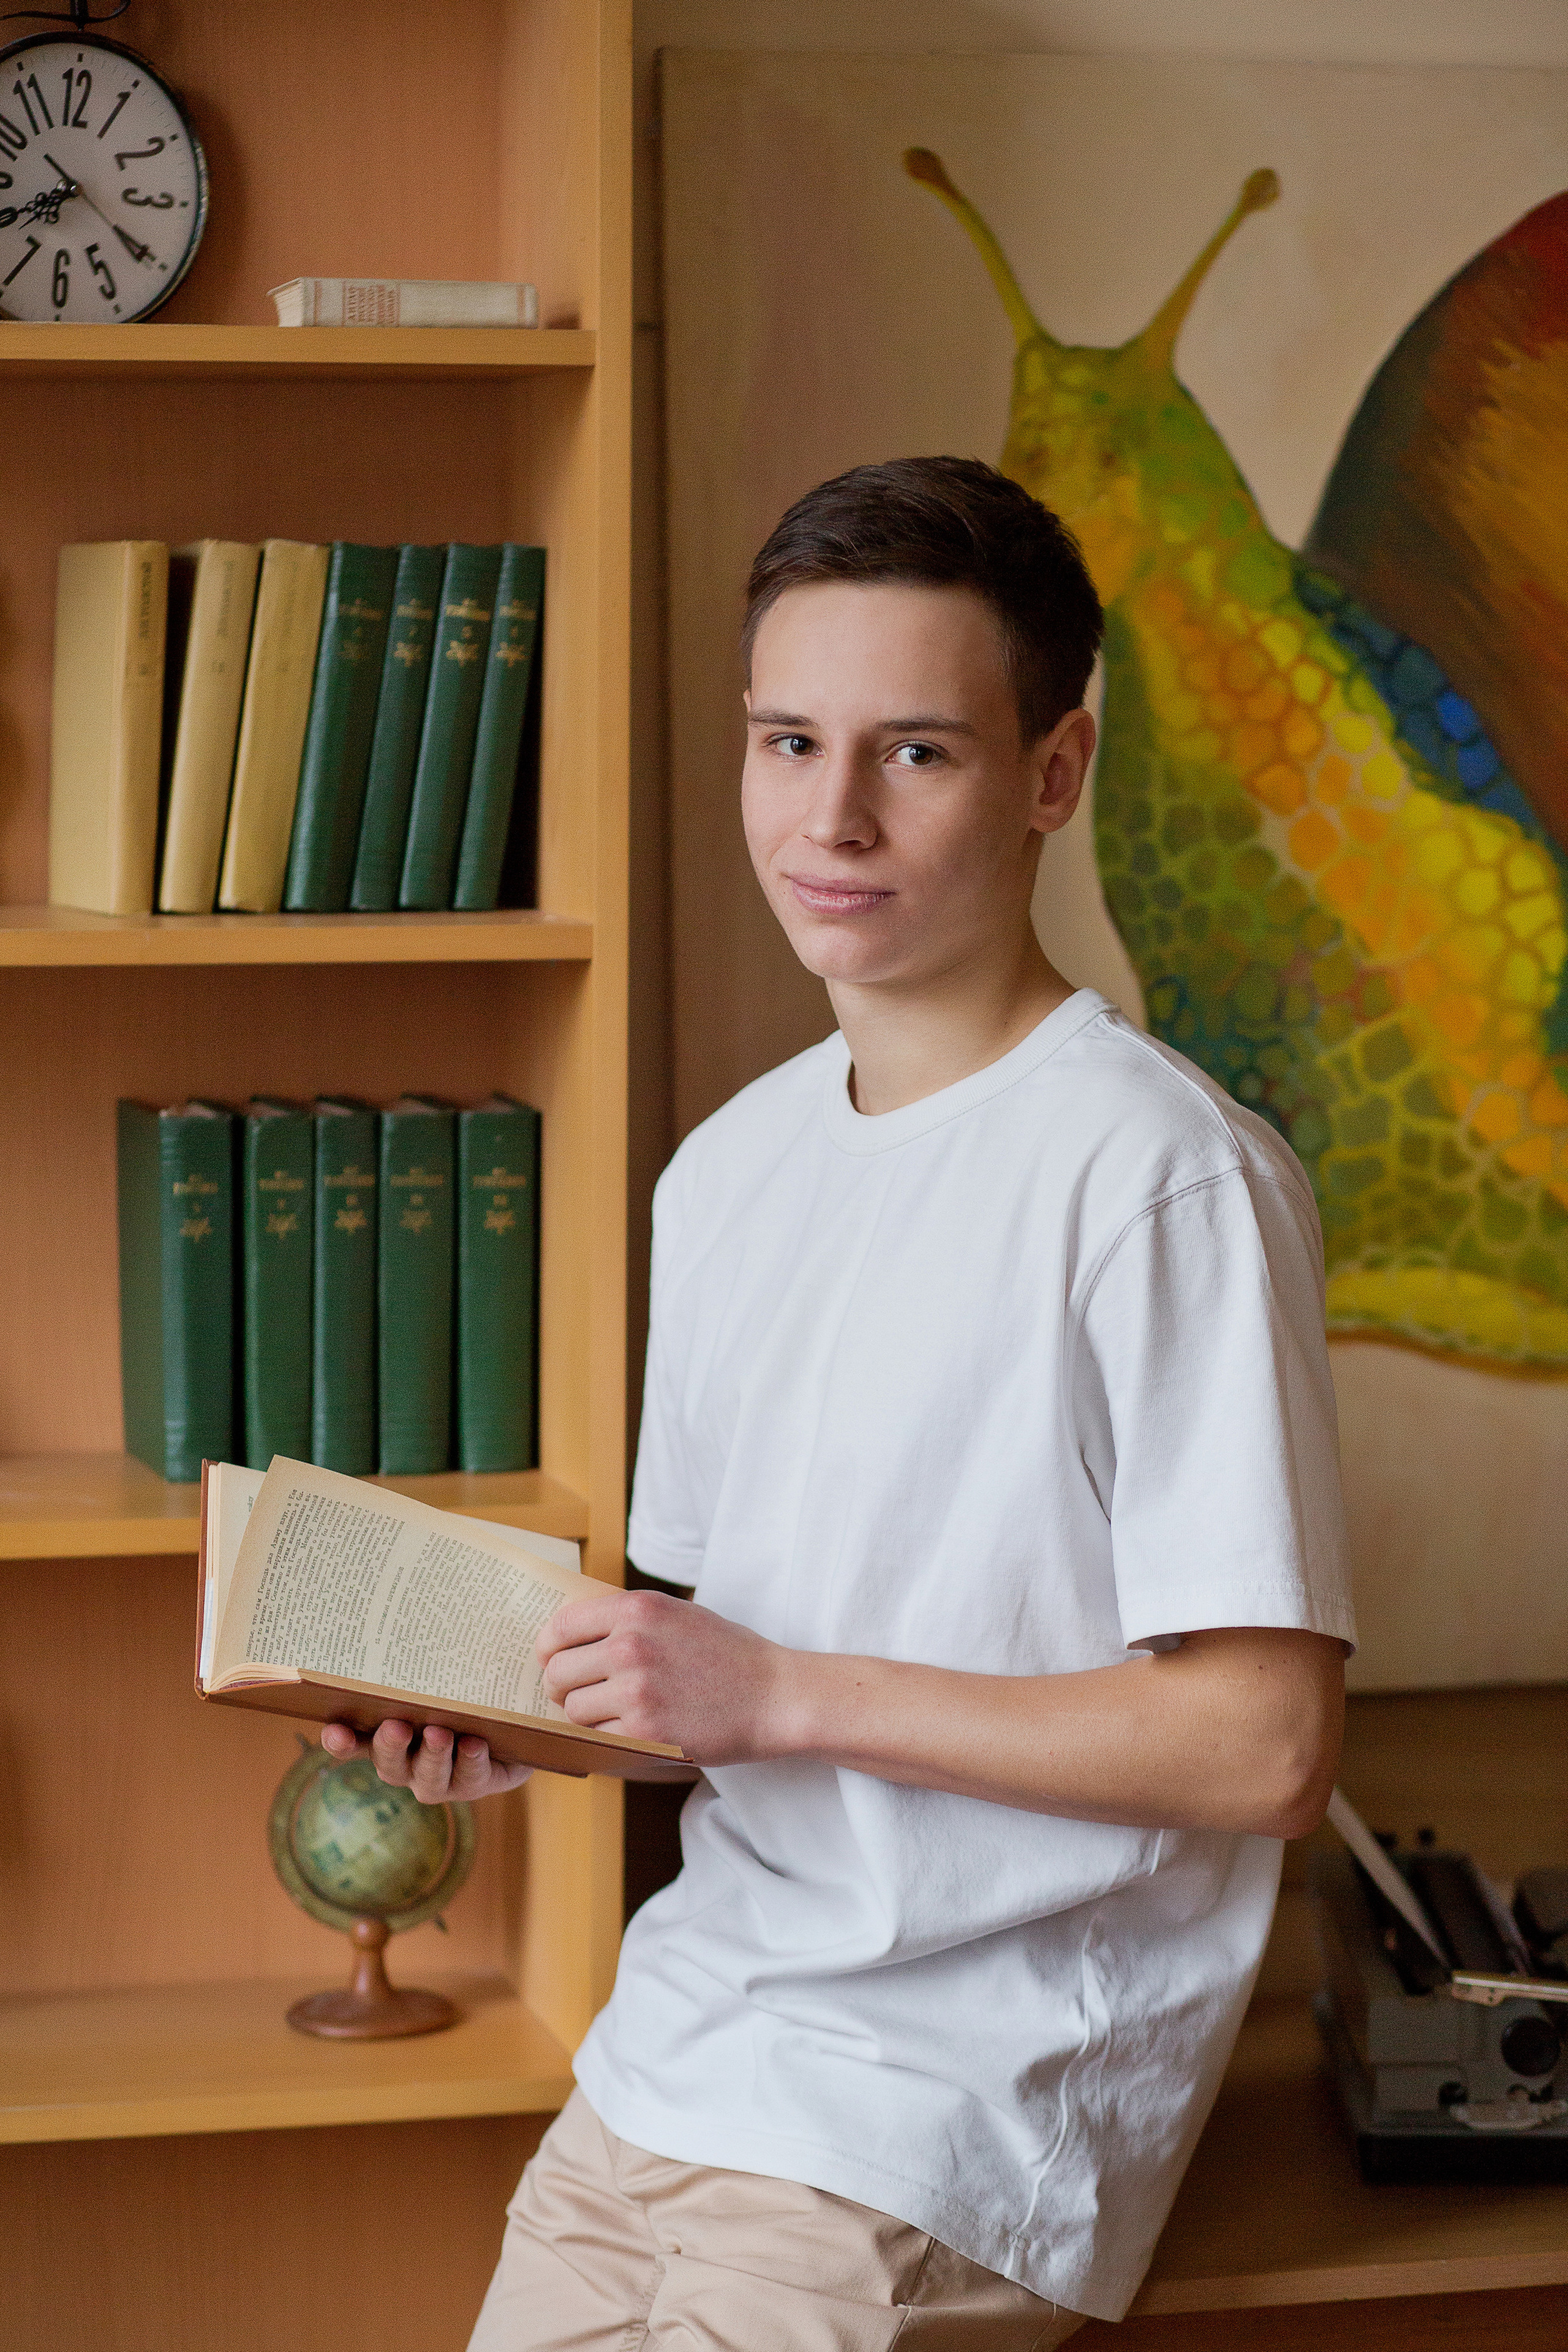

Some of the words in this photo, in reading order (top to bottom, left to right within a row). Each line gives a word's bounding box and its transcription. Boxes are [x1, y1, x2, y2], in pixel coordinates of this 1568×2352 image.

[13, 74, 55, 135] 11
[62, 67, 92, 129] 12
[97, 91, 131, 140] 1
[115, 137, 165, 171] 2
[122, 188, 173, 209] 3
[2, 235, 41, 286] 7
[52, 248, 70, 309] 6
[85, 243, 116, 300] 5
[321, 1528, 328, 1536] бы
[326, 1500, 341, 1526] охранить
[258, 1567, 270, 1594] Господь
[271, 1528, 282, 1548] Адаму
[279, 1509, 290, 1525] плуг,
[259, 1602, 268, 1624] время,
[273, 1537, 287, 1570] нарушили
[284, 1509, 297, 1535] заповедь
[265, 1625, 270, 1634] из
[270, 1571, 283, 1602] Согласно
[282, 1547, 290, 1562] этим
[288, 1504, 306, 1544] напечатанная
[271, 1603, 282, 1639] повествует
[281, 1580, 289, 1594] том,
[288, 1537, 302, 1562] Господь
[300, 1513, 311, 1536] выучил
[307, 1494, 318, 1512] людей
[282, 1587, 294, 1620] запрягать
[292, 1555, 304, 1581] лошадь.
[301, 1528, 313, 1550] Между
[312, 1496, 326, 1523] русскими
[295, 1577, 304, 1599] другое
[301, 1546, 314, 1575] предание
[314, 1509, 330, 1537] постройке
[305, 1553, 320, 1588] придумать,
[312, 1602, 318, 1613] бы
[317, 1576, 327, 1599] хороша
[328, 1540, 340, 1560] тепло,
[340, 1513, 352, 1532] уютно,
[324, 1582, 332, 1594] Уж
[330, 1561, 339, 1578] ангел
[336, 1528, 353, 1557] Господень
[350, 1507, 362, 1526] научил
[334, 1571, 343, 1589] стали
[341, 1553, 350, 1569] люди
[348, 1529, 360, 1551] строить
[340, 1600, 349, 1617] Злой
[347, 1583, 355, 1597] дух,
[358, 1526, 378, 1566] представитель
[369, 1536, 380, 1555] боится
[296, 1623, 307, 1654] непогоды
[314, 1558, 325, 1584] наконец
[329, 1510, 345, 1539] ухитрился
[298, 1592, 308, 1613] умели
[323, 1629, 335, 1661] Предание
[350, 1546, 360, 1566] печать
[358, 1526, 369, 1544] весьма
[347, 1589, 361, 1621] народным
[403, 1597, 413, 1618] одного
[410, 1566, 426, 1593] Соломона
[296, 1616, 301, 1624] не
[345, 1623, 350, 1632] по
[347, 1625, 358, 1654] первыми
[355, 1597, 366, 1621] лучами
[357, 1618, 366, 1643] исходит
[377, 1604, 390, 1635] СОЛОМОН
[382, 1639, 393, 1667] Христос
[390, 1618, 399, 1636] после
[397, 1586, 410, 1615] распятия
[408, 1566, 418, 1583] сошел
[409, 1618, 421, 1645] Соломон
